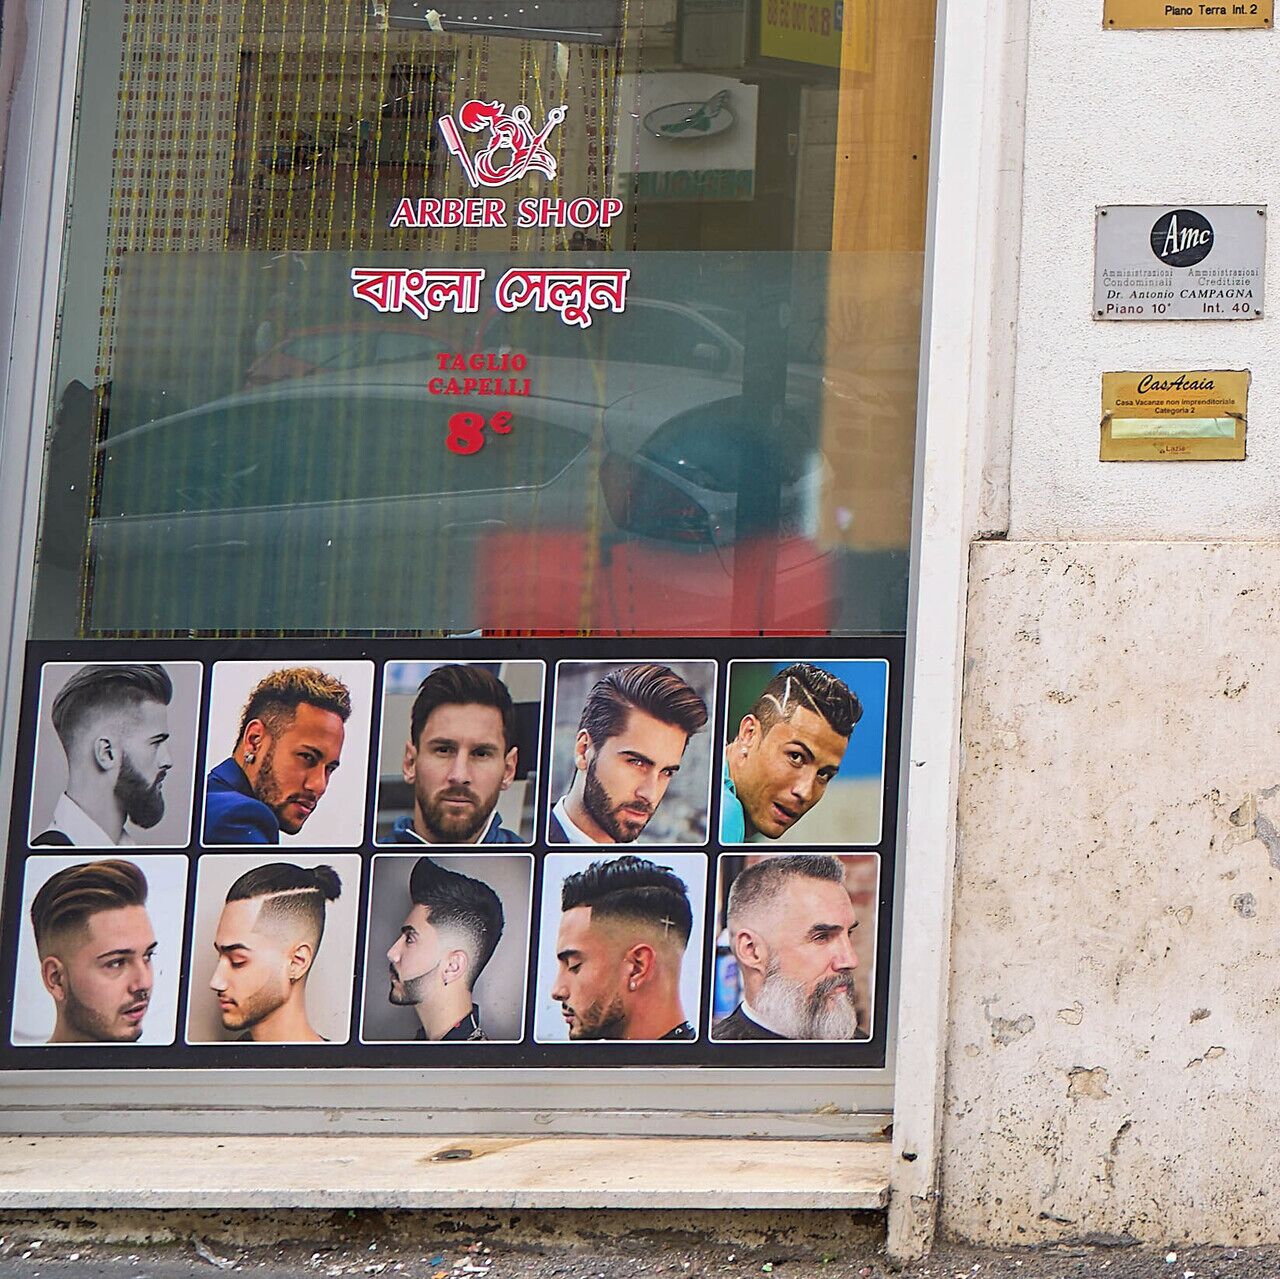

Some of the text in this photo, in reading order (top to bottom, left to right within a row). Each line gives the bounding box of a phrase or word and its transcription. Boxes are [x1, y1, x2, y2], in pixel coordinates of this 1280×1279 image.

[1165, 4, 1258, 16] Piano Terra Int. 2
[390, 197, 623, 227] ARBER SHOP
[1161, 214, 1211, 257] Amc
[1103, 278, 1172, 287] Condominiali
[1198, 277, 1251, 286] Creditizie
[351, 267, 630, 328] বাংলা সেলুন
[1107, 289, 1253, 299] Dr. Antonio CAMPAGNA
[1107, 303, 1144, 314] Piano
[1203, 303, 1250, 313] Int. 40
[436, 352, 528, 372] TAGLIO
[427, 377, 532, 397] CAPELLI
[1137, 374, 1215, 394] CasAcaia
[1181, 398, 1235, 406] imprenditoriale
[1154, 407, 1189, 415] Categoria
[445, 410, 513, 455] 8€
